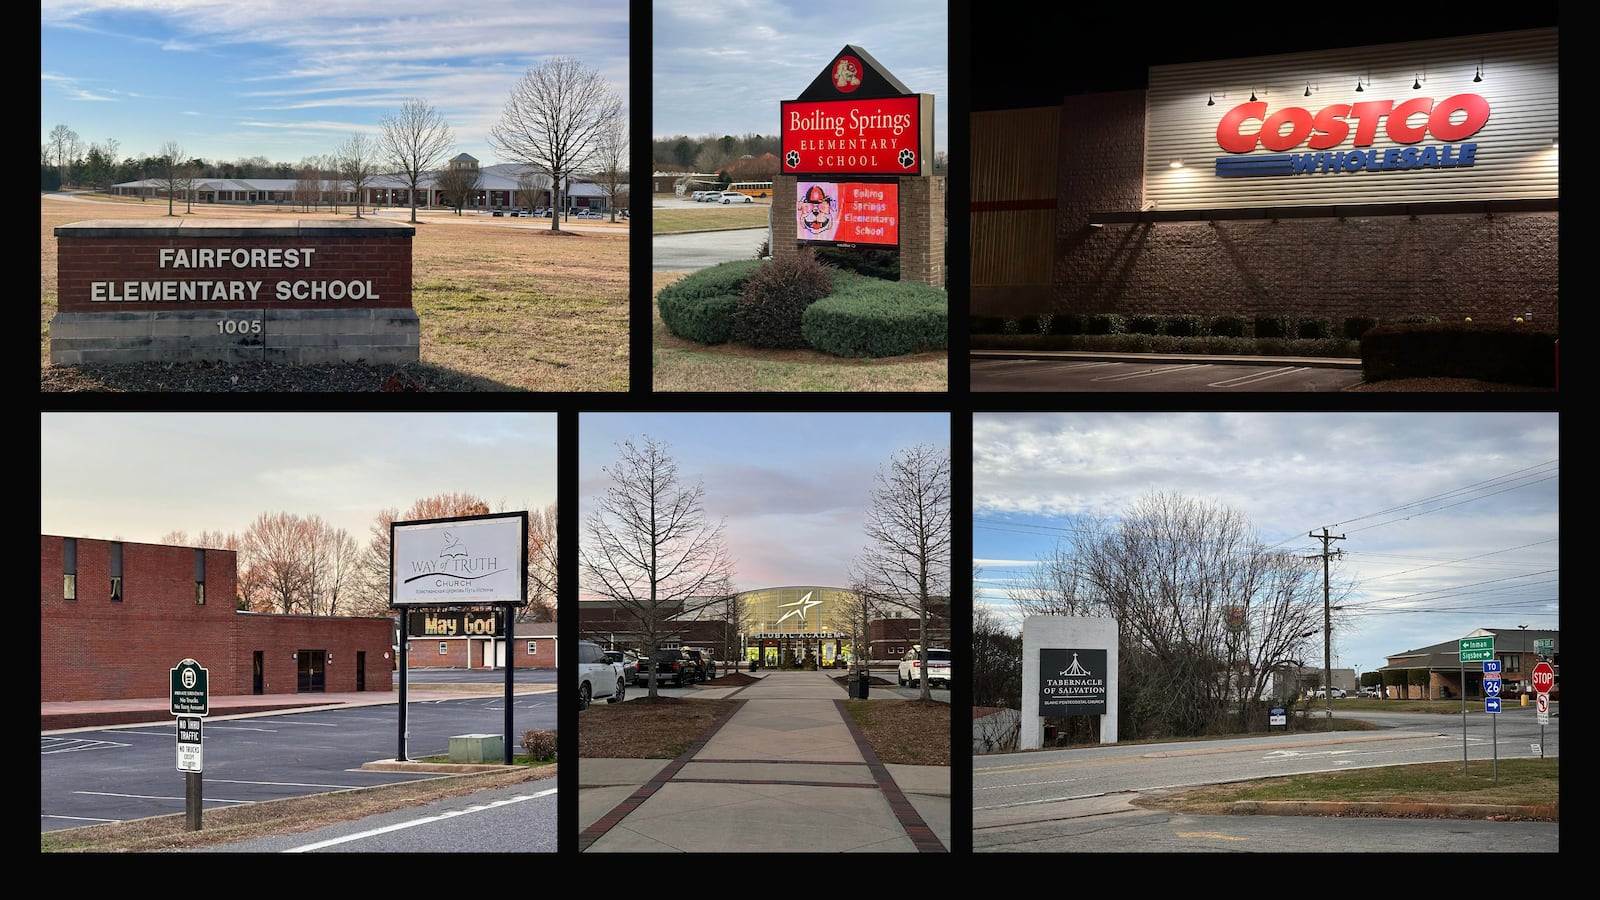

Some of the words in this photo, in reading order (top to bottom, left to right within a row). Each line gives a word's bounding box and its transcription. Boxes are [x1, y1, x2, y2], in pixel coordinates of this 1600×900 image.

[790, 109, 845, 137] Boiling
[849, 108, 911, 136] Springs
[801, 138, 898, 150] ELEMENTARY
[818, 155, 878, 167] SCHOOL
[1291, 143, 1478, 175] WHOLESALE
[853, 188, 883, 200] Boiling
[852, 200, 887, 213] Springs
[844, 212, 896, 226] Elementary
[855, 225, 884, 237] School
[159, 248, 315, 268] FAIRFOREST
[90, 280, 262, 301] ELEMENTARY
[275, 279, 380, 300] SCHOOL
[216, 320, 262, 334] 1005
[411, 560, 438, 573] WAY
[440, 559, 449, 572] of
[453, 557, 497, 573] TRUTH
[425, 613, 457, 635] May
[464, 612, 496, 635] God
[1462, 651, 1483, 660] Sigsbee
[1487, 663, 1497, 671] TO
[1533, 672, 1552, 685] STOP
[1486, 681, 1499, 693] 26
[180, 720, 186, 729] NO
[180, 731, 199, 741] TRAFFIC
